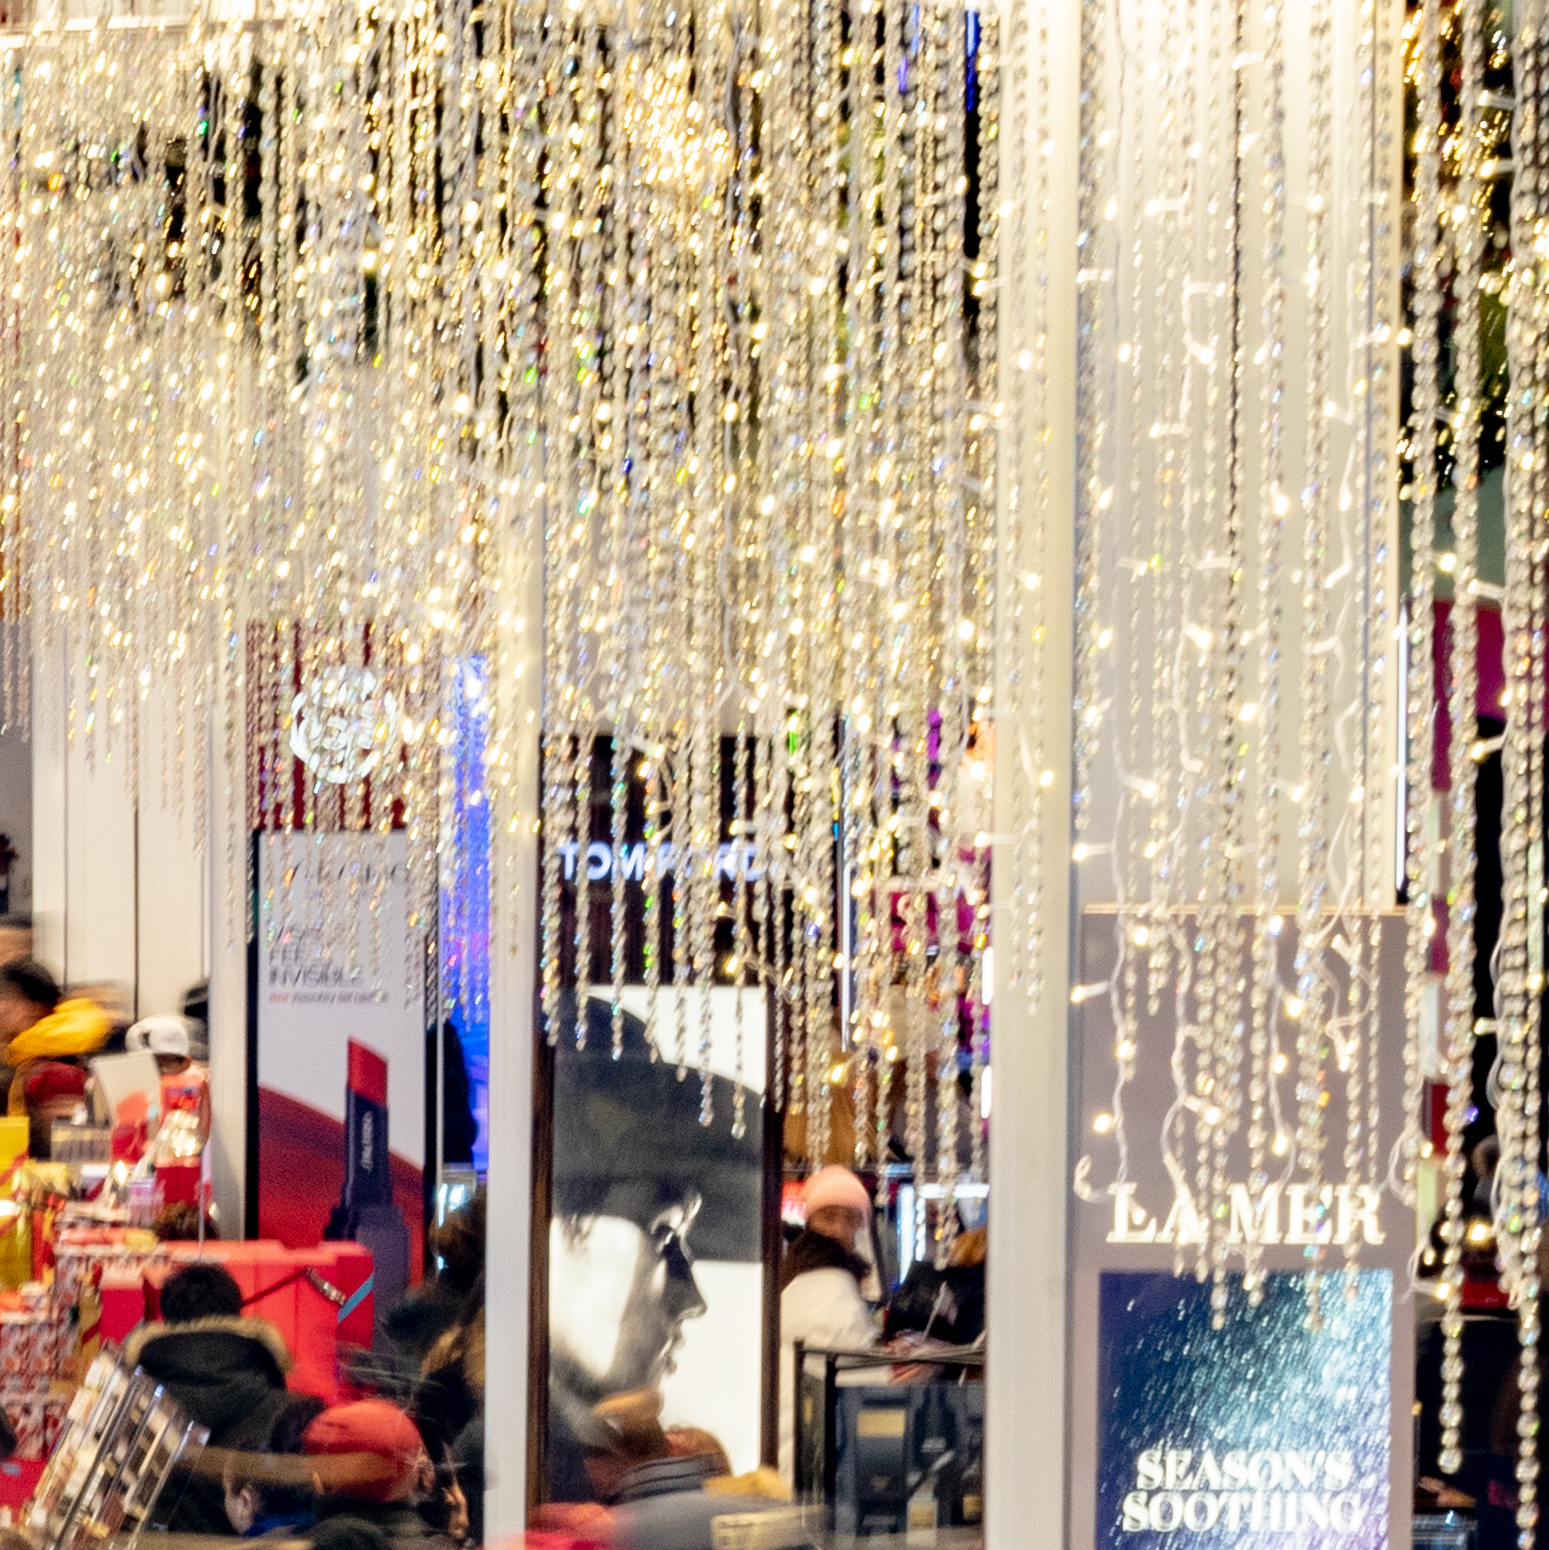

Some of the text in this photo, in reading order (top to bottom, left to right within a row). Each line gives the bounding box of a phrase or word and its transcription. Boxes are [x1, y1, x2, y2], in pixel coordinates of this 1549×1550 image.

[557, 841, 764, 882] TOM FRD
[1106, 1183, 1386, 1245] LA MER
[1136, 1449, 1354, 1491] SEASON'S
[1122, 1490, 1368, 1533] SOOTHING
